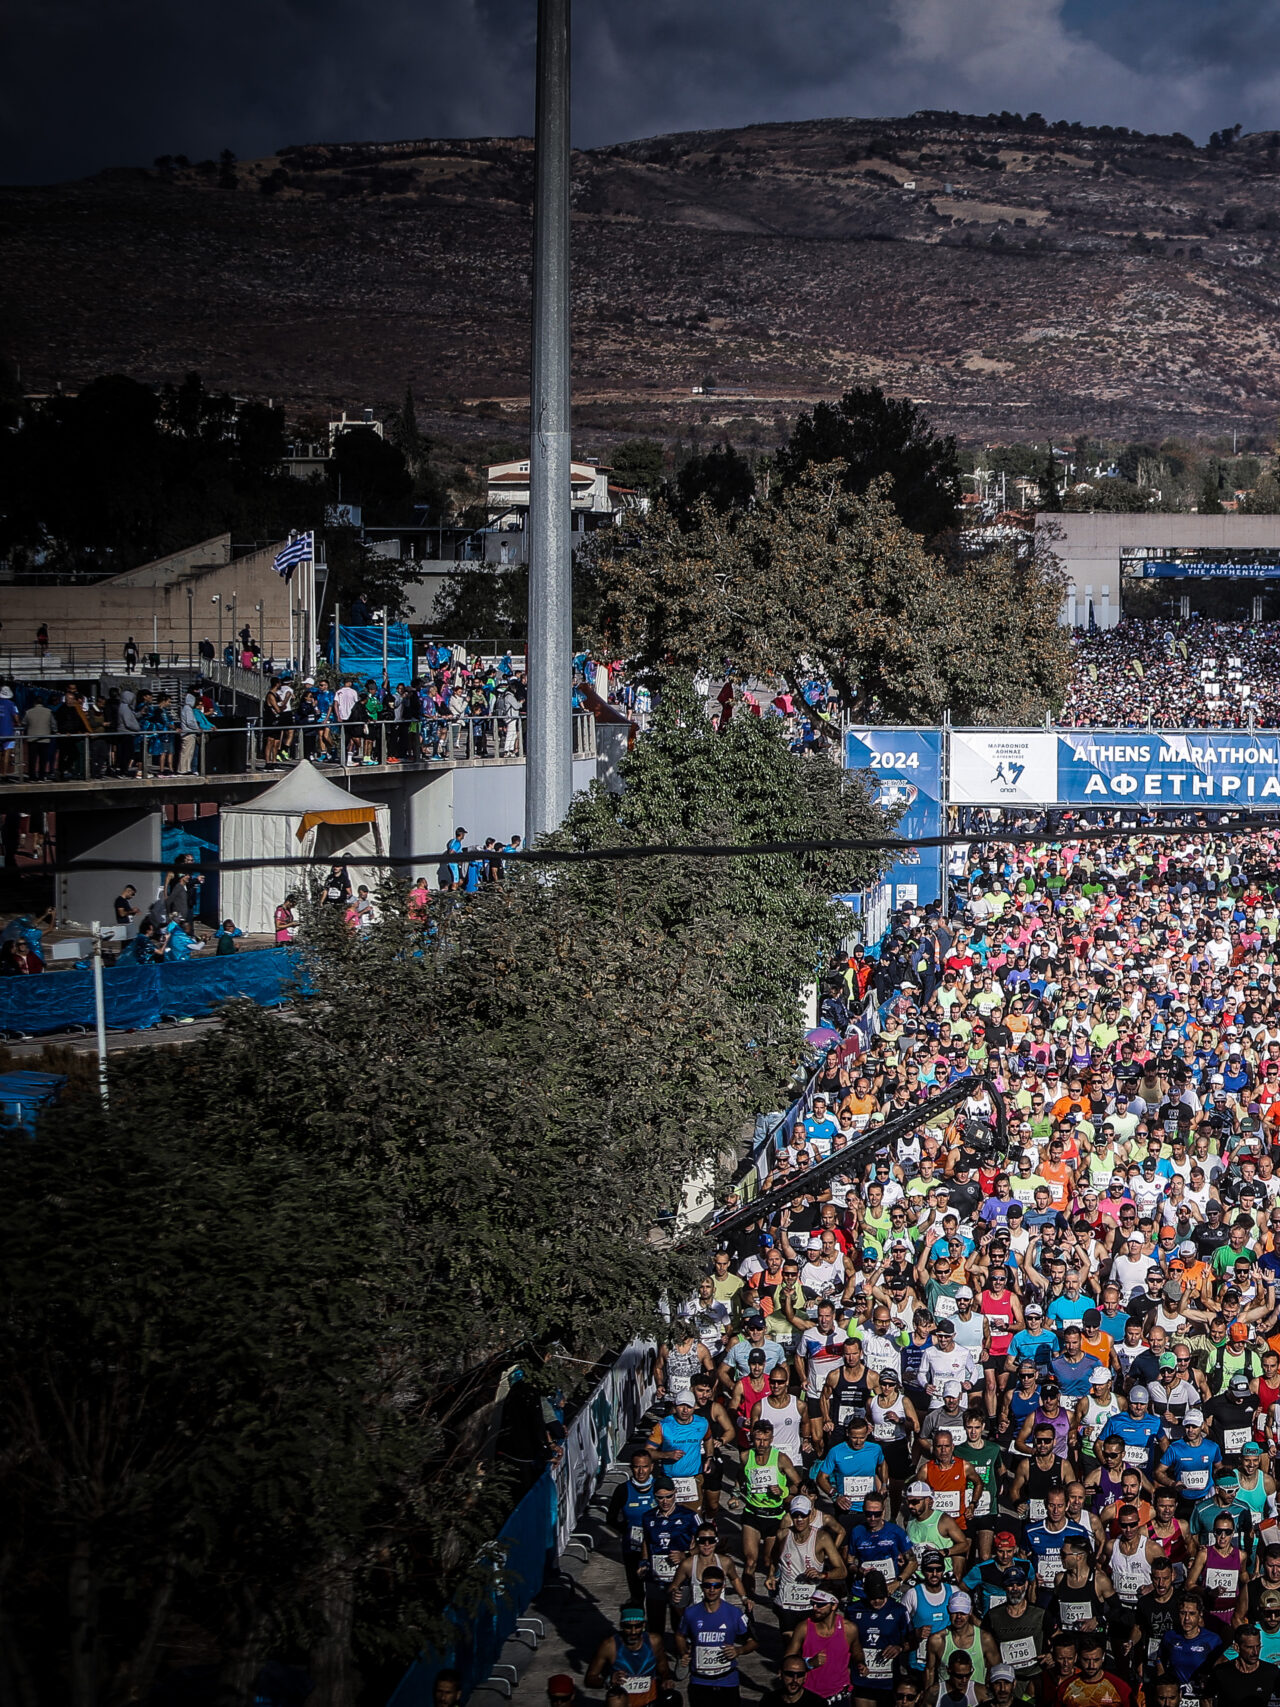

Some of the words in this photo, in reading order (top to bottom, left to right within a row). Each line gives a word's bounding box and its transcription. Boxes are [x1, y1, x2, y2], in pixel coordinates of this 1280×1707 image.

[1210, 568, 1265, 576] AUTHENTIC
[1073, 746, 1150, 763] ATHENS
[870, 752, 919, 769] 2024
[755, 1476, 772, 1484] 1253
[850, 1485, 868, 1493] 3317
[936, 1500, 954, 1508] 2269
[1120, 1583, 1137, 1591] 1449
[1214, 1579, 1232, 1587] 1628
[698, 1631, 725, 1643] ATHENS
[1009, 1649, 1029, 1659] 1796
[628, 1681, 649, 1690] 1782
